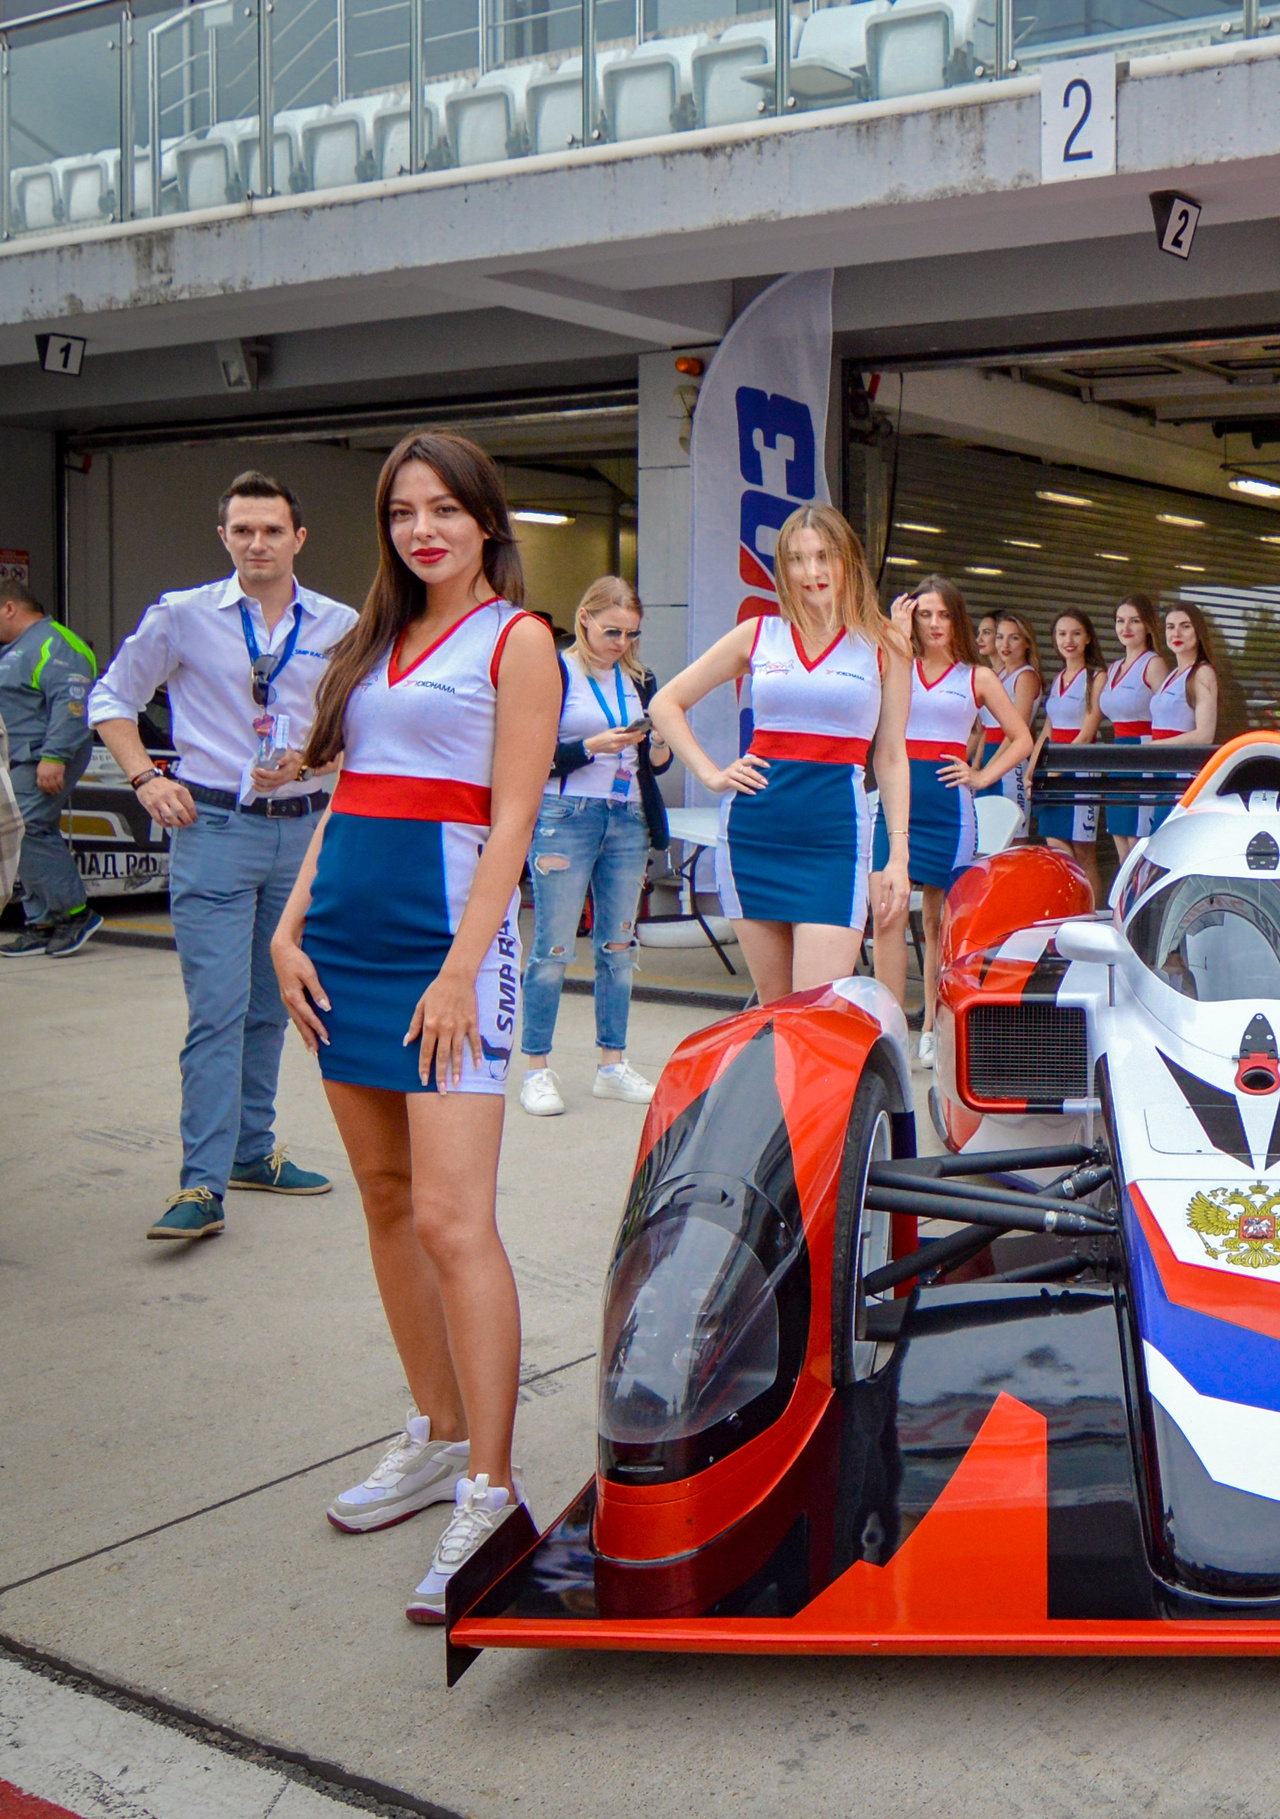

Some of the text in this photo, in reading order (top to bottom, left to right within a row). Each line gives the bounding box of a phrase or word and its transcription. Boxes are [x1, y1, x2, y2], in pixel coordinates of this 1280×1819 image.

[1062, 78, 1093, 162] 2
[1170, 208, 1190, 250] 2
[59, 341, 72, 369] 1
[496, 964, 517, 1035] SMP
